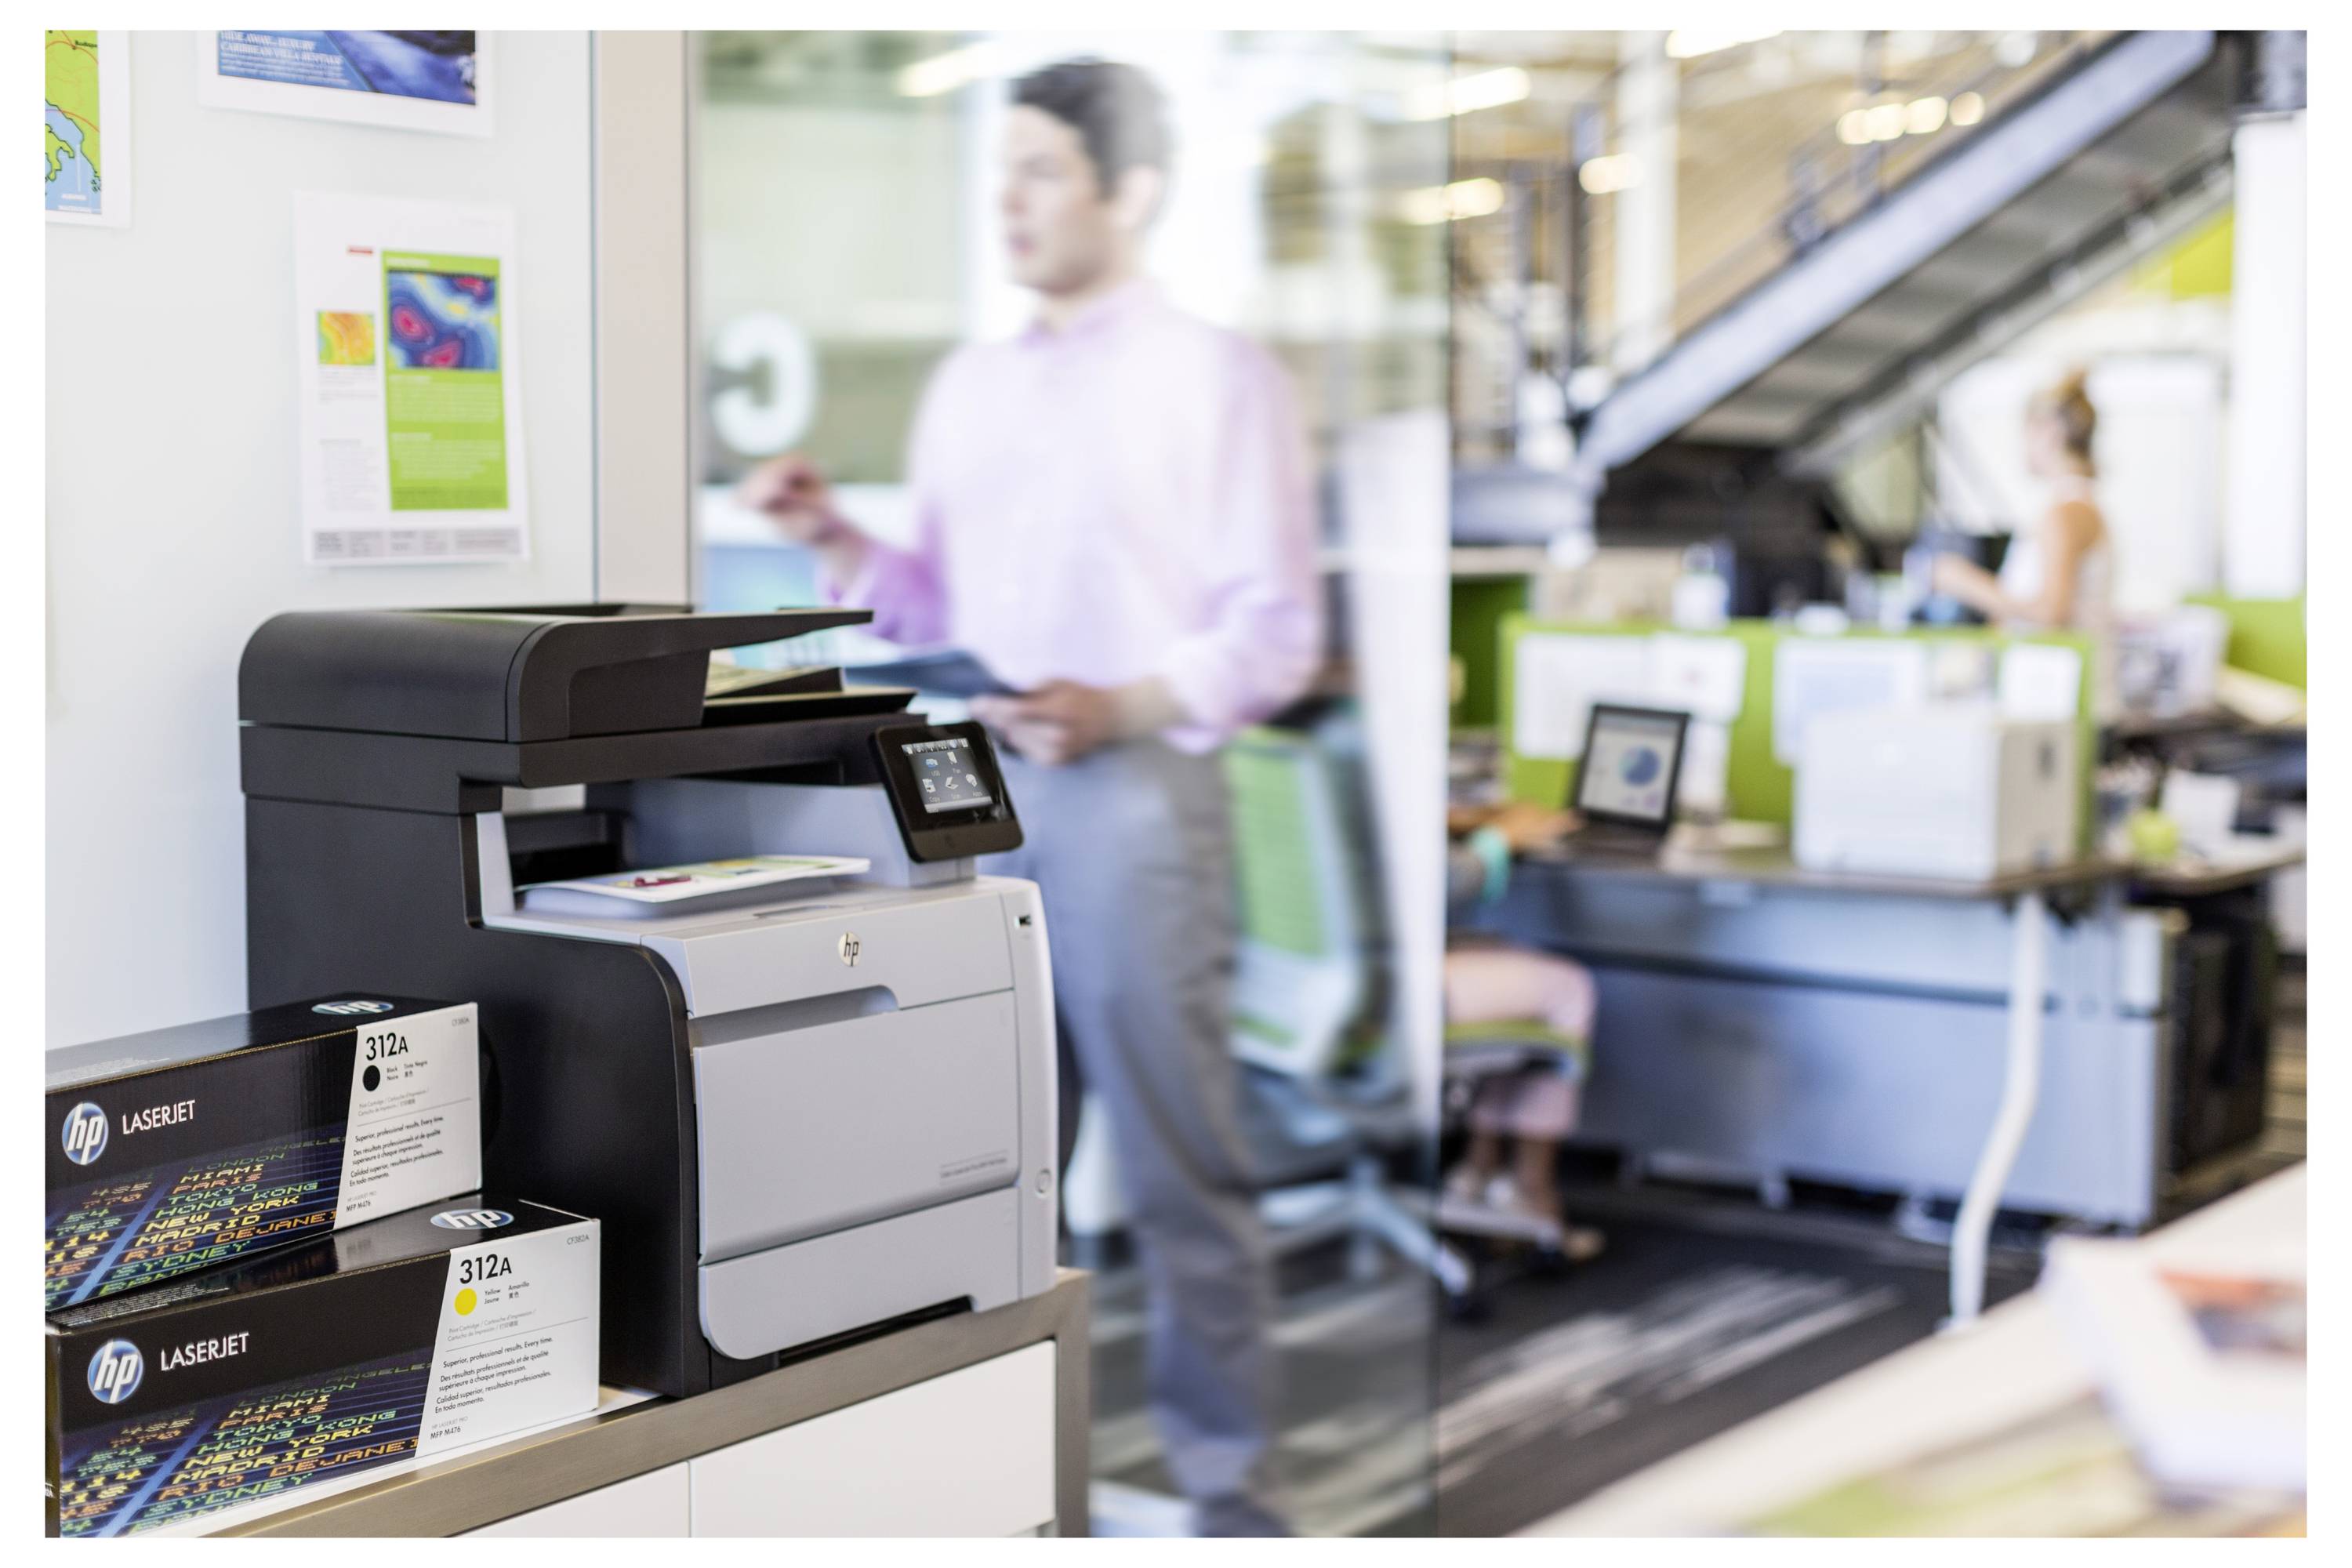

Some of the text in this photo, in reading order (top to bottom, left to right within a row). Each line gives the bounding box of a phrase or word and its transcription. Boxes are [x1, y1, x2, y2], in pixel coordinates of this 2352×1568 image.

[844, 933, 859, 967] hp
[366, 1033, 408, 1061] 312A
[65, 1099, 195, 1165] hp LASERJET
[377, 1125, 404, 1137] professional
[188, 1152, 285, 1173] LONDON
[381, 1150, 397, 1159] chaque
[180, 1163, 264, 1184] MIAMI
[351, 1167, 369, 1178] Calidad
[390, 1158, 412, 1167] resultados
[168, 1182, 257, 1205] TOKYO
[172, 1173, 262, 1194] PARIS
[155, 1181, 318, 1218] HONG KONG
[346, 1203, 357, 1212] MFP
[144, 1196, 299, 1232] NEW YORK
[439, 1210, 503, 1229] hp
[135, 1214, 260, 1247] MADRID
[567, 1235, 590, 1245] CF382A
[111, 1240, 251, 1279] SYDNEY
[123, 1241, 194, 1263] RIO
[459, 1254, 512, 1284] 312A
[508, 1281, 529, 1291] Amarillo
[443, 1336, 553, 1368] Superior, professional results. Every time.
[92, 1331, 249, 1404] hp LASERJET
[474, 1373, 495, 1383] chaque
[495, 1366, 526, 1377] impression.
[476, 1359, 515, 1374] professionnels
[238, 1382, 356, 1407] LONDON
[437, 1370, 551, 1404] Calidad superior, resultados profesionales.
[228, 1394, 330, 1418] MIAMI
[457, 1397, 484, 1408] momento.
[213, 1414, 322, 1440] TOKYO
[218, 1403, 328, 1429] PARIS
[198, 1410, 397, 1455] HONG KONG
[430, 1427, 461, 1439] MFP M476
[184, 1425, 373, 1469] NEW YORK
[172, 1446, 325, 1485] MADRID
[143, 1472, 314, 1519] SYDNEY
[158, 1474, 245, 1501] RIO
